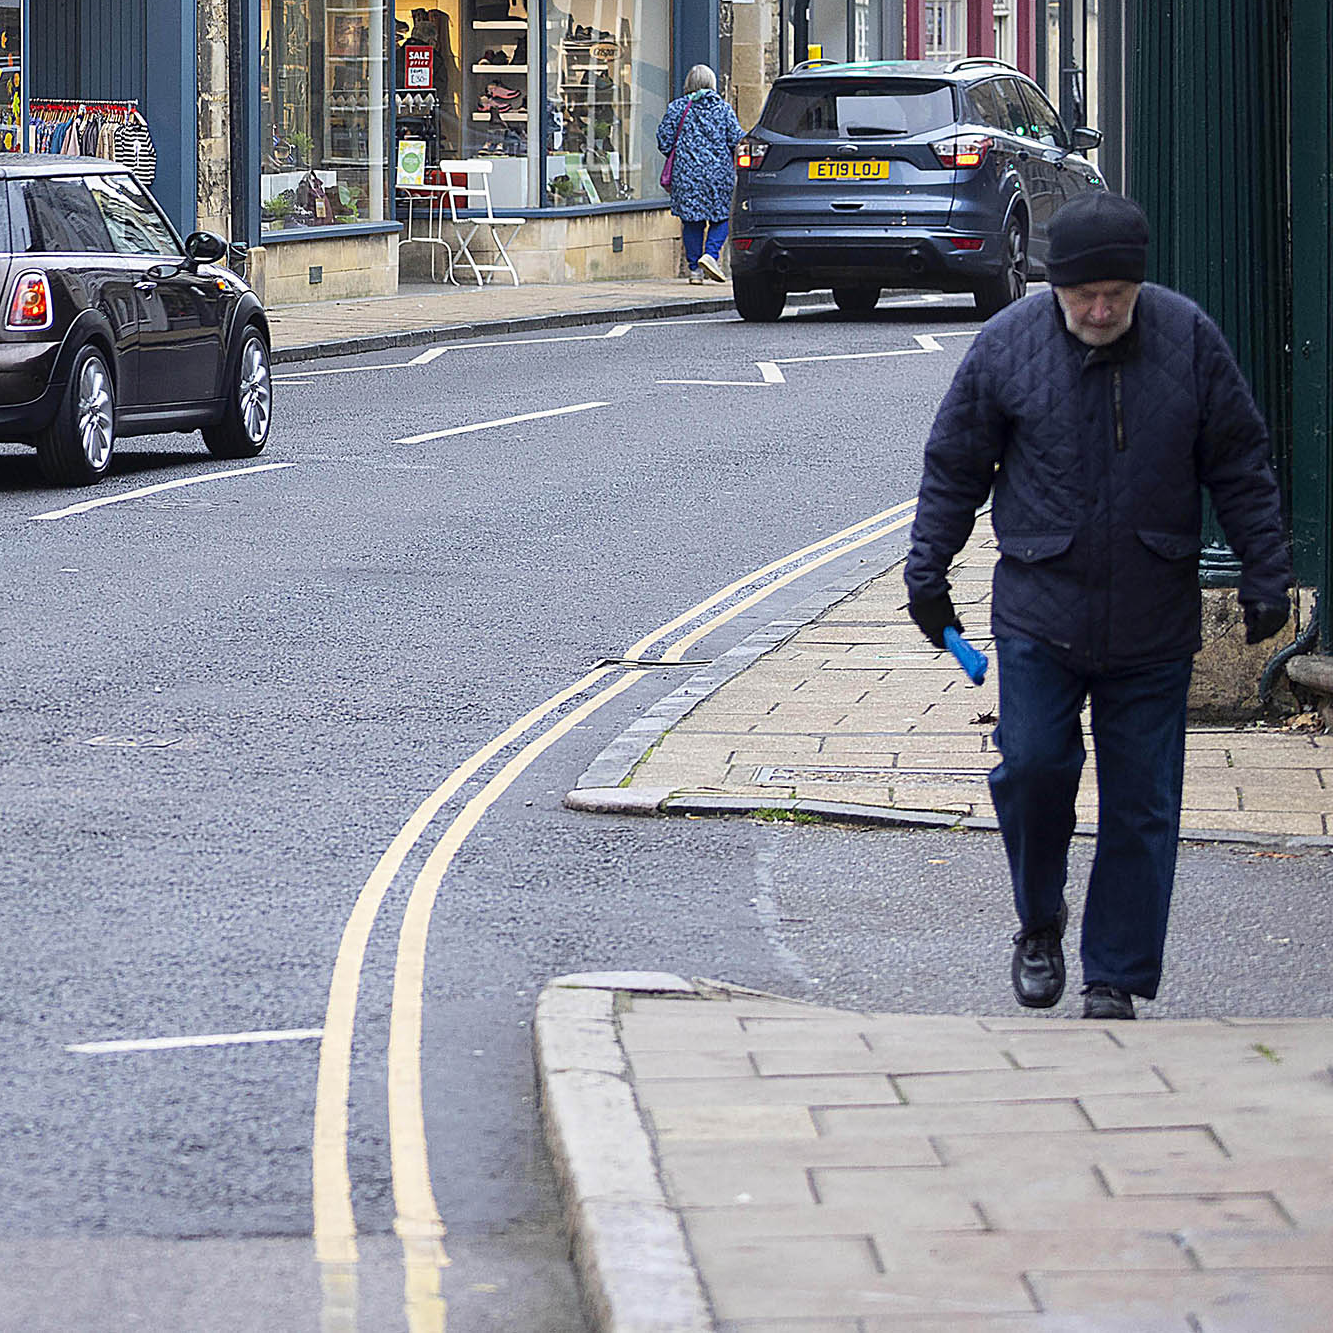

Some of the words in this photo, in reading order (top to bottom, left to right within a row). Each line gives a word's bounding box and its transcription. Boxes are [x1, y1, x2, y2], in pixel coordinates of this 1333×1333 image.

[408, 51, 430, 60] SALE
[817, 163, 849, 177] ET19
[852, 163, 881, 177] LOJ
